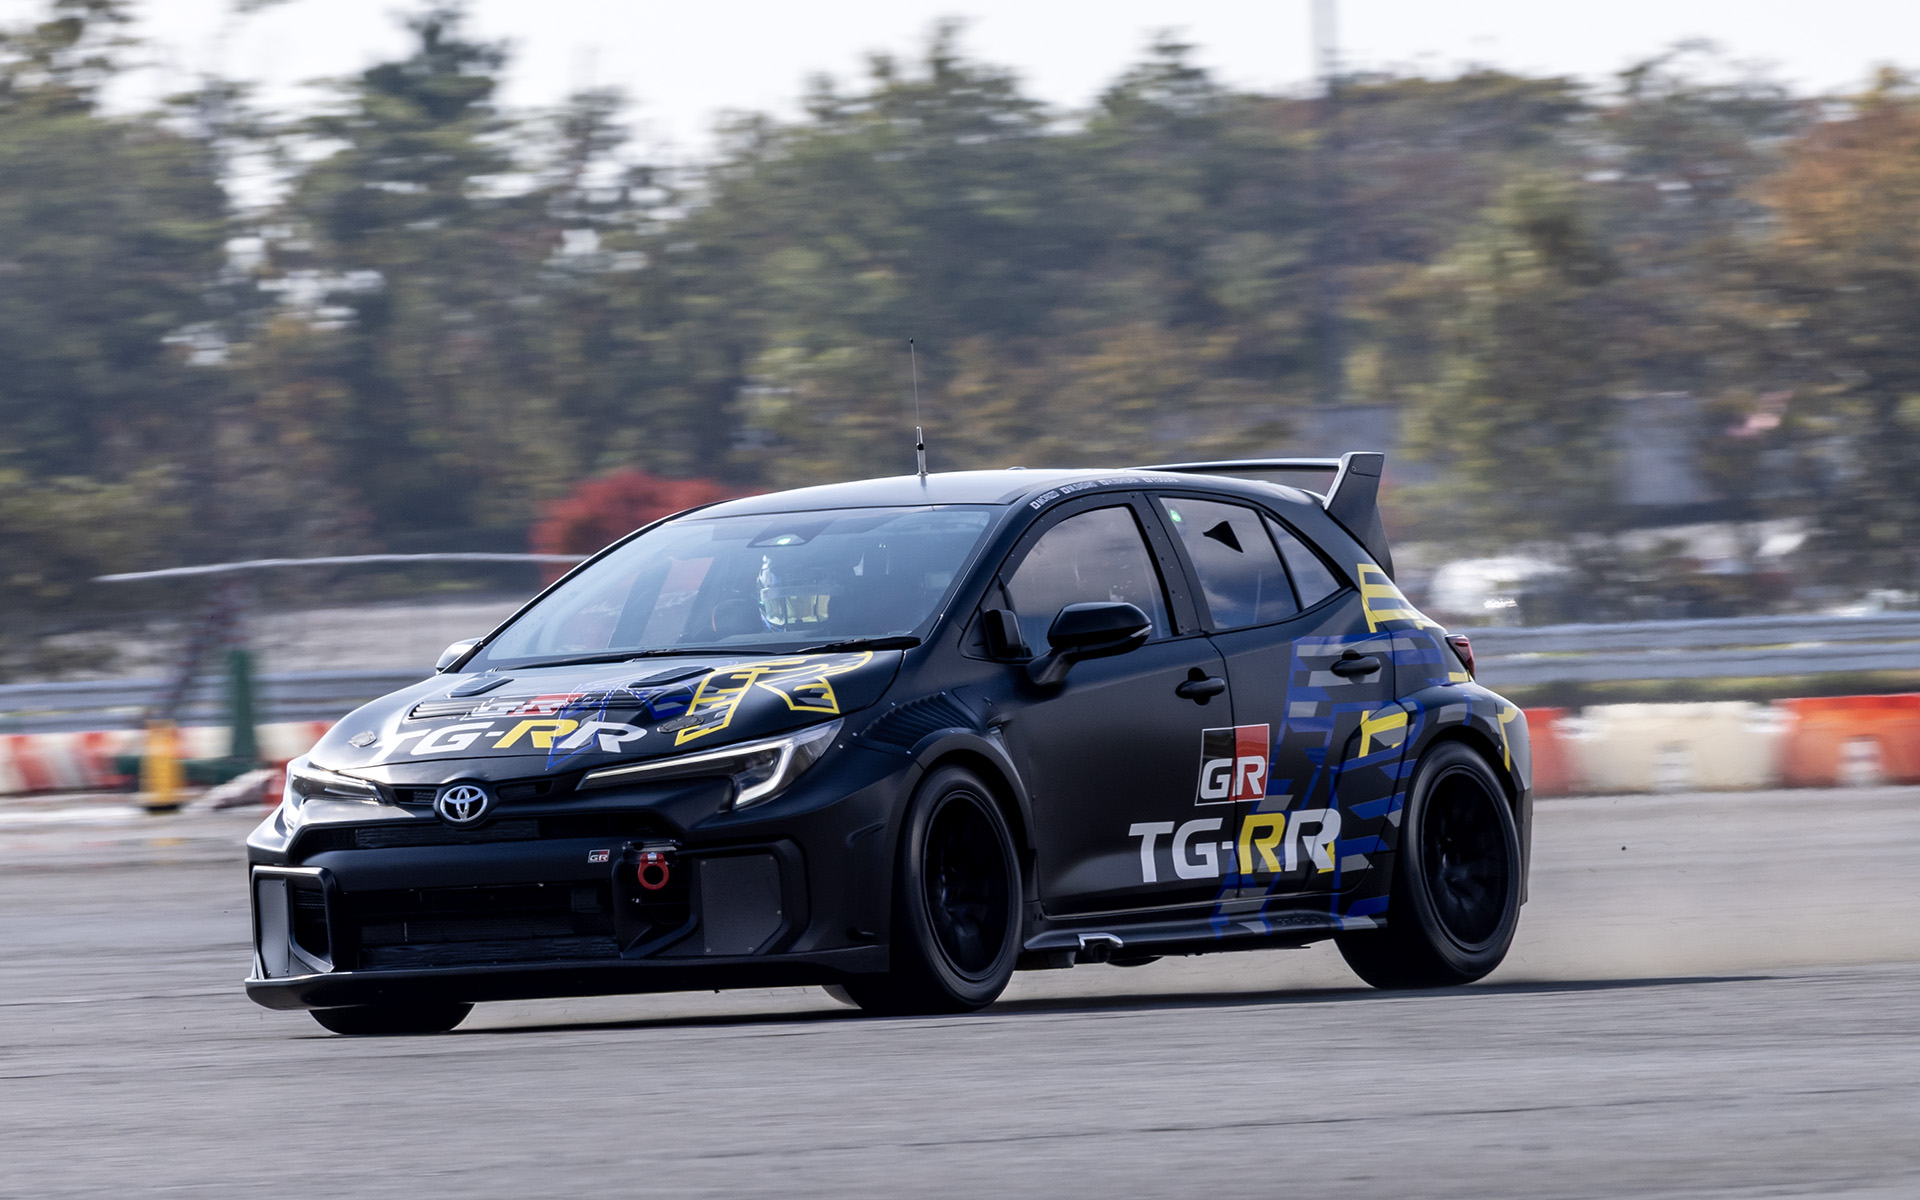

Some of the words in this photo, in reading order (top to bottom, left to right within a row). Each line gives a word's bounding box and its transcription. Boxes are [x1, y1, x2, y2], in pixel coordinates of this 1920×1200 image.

[367, 719, 648, 766] TG-RR
[1200, 755, 1266, 799] GR
[1128, 808, 1342, 883] TG-RR
